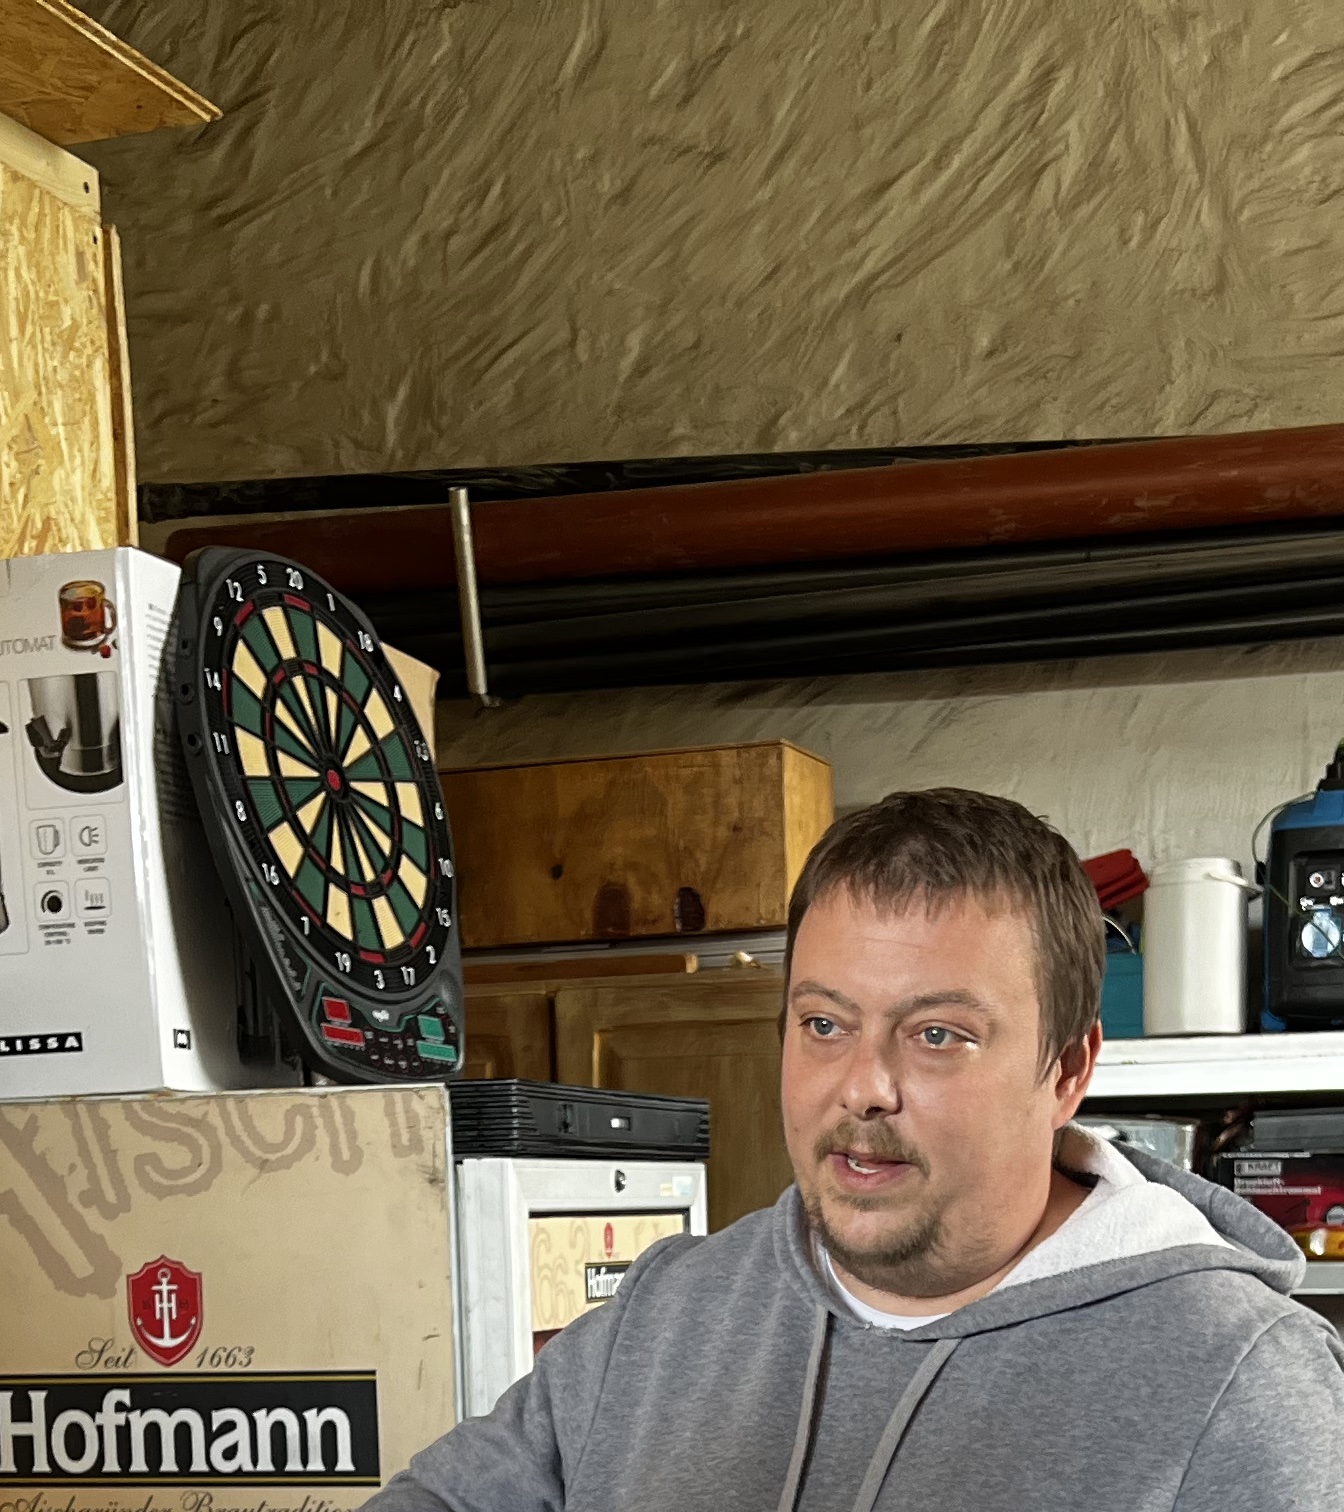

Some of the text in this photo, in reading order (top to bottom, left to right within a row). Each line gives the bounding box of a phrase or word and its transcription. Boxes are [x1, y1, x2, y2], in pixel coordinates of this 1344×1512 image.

[257, 565, 267, 585] 5
[286, 567, 304, 590] 20
[226, 579, 244, 601] 12
[326, 593, 336, 611] 1
[213, 616, 223, 636] 9
[358, 630, 374, 652] 18
[204, 668, 221, 691] 14
[213, 732, 230, 755] 11
[235, 800, 247, 821] 8
[435, 802, 444, 820] 6
[262, 863, 280, 885] 16
[438, 858, 454, 878] 10
[301, 916, 310, 935] 7
[436, 908, 452, 927] 15
[335, 951, 352, 974] 19
[426, 945, 437, 964] 2
[374, 970, 385, 989] 3
[400, 966, 415, 986] 17
[75, 1337, 255, 1370] Seit 1663
